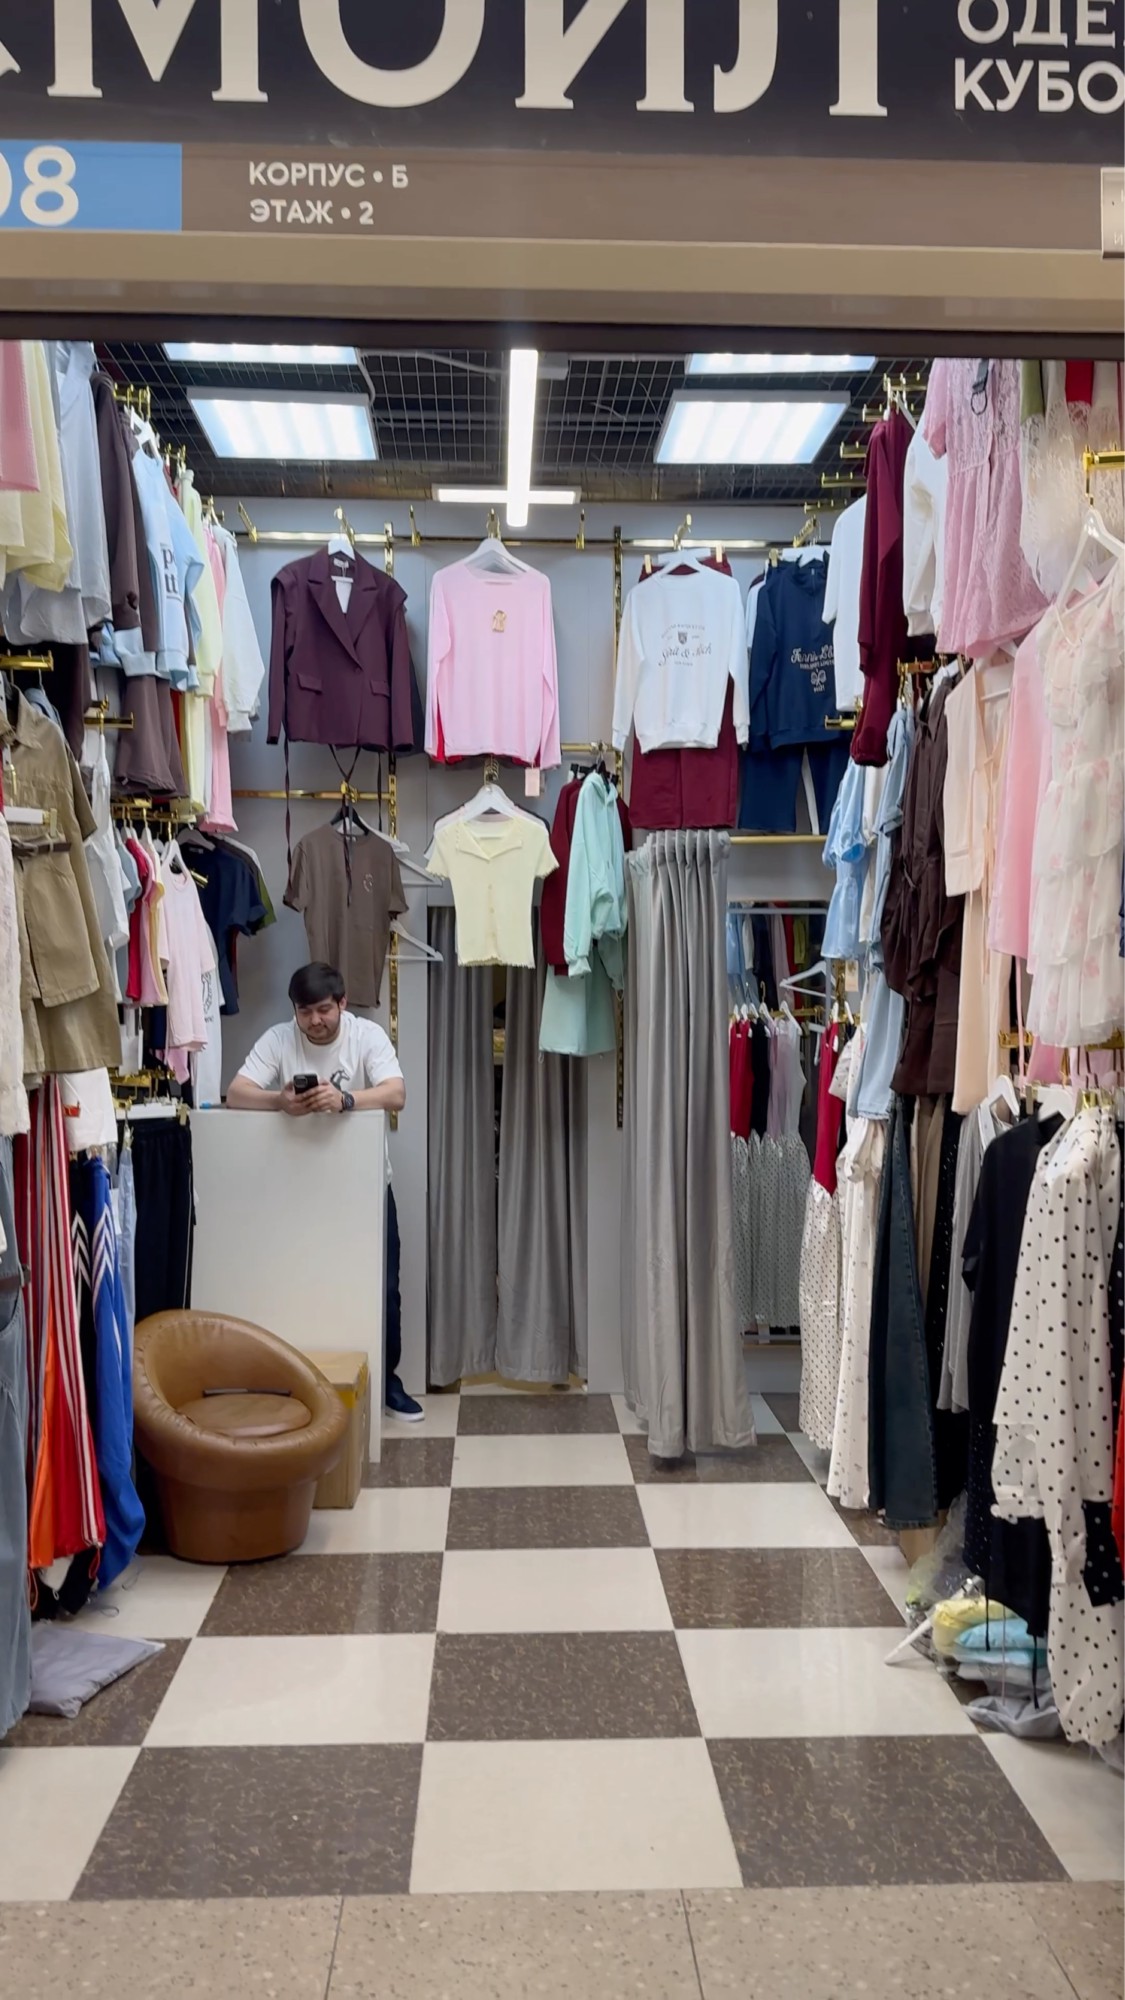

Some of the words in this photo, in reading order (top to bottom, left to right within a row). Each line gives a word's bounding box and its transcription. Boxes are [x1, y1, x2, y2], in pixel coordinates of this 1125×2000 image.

[957, 0, 1125, 48] ОДЕ
[0, 0, 888, 116] МОИЛ
[954, 57, 1125, 114] КУБО
[0, 144, 79, 227] 8
[249, 161, 366, 188] КОРПУС
[392, 164, 409, 188] Б
[249, 198, 334, 224] ЭТАЖ
[358, 201, 374, 225] 2
